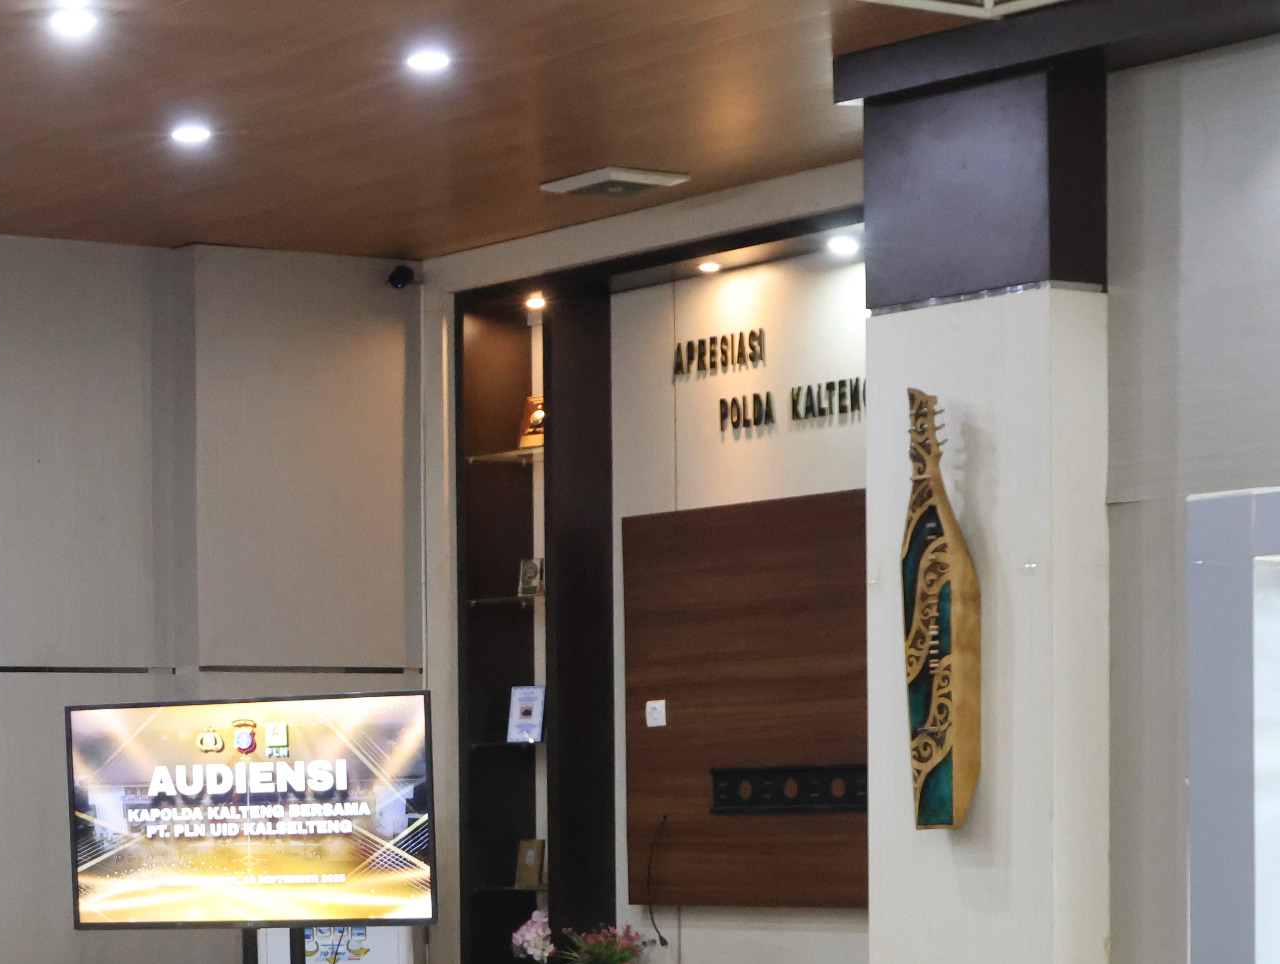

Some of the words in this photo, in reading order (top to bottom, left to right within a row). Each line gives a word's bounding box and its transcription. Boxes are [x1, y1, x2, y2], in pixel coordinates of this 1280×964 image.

[673, 328, 765, 376] APRESIASI
[719, 391, 776, 432] POLDA
[791, 377, 867, 421] KALTEN
[264, 747, 290, 758] PLN
[147, 758, 348, 797] AUDIENSI
[127, 805, 204, 822] KAPOLDA
[206, 804, 284, 821] KALTENG
[288, 802, 371, 818] BERSAMA
[146, 824, 171, 839] PT.
[174, 822, 206, 838] PLN
[210, 821, 240, 837] UID
[242, 818, 353, 836] KALSELTENG
[258, 874, 319, 884] SEPTEMBER
